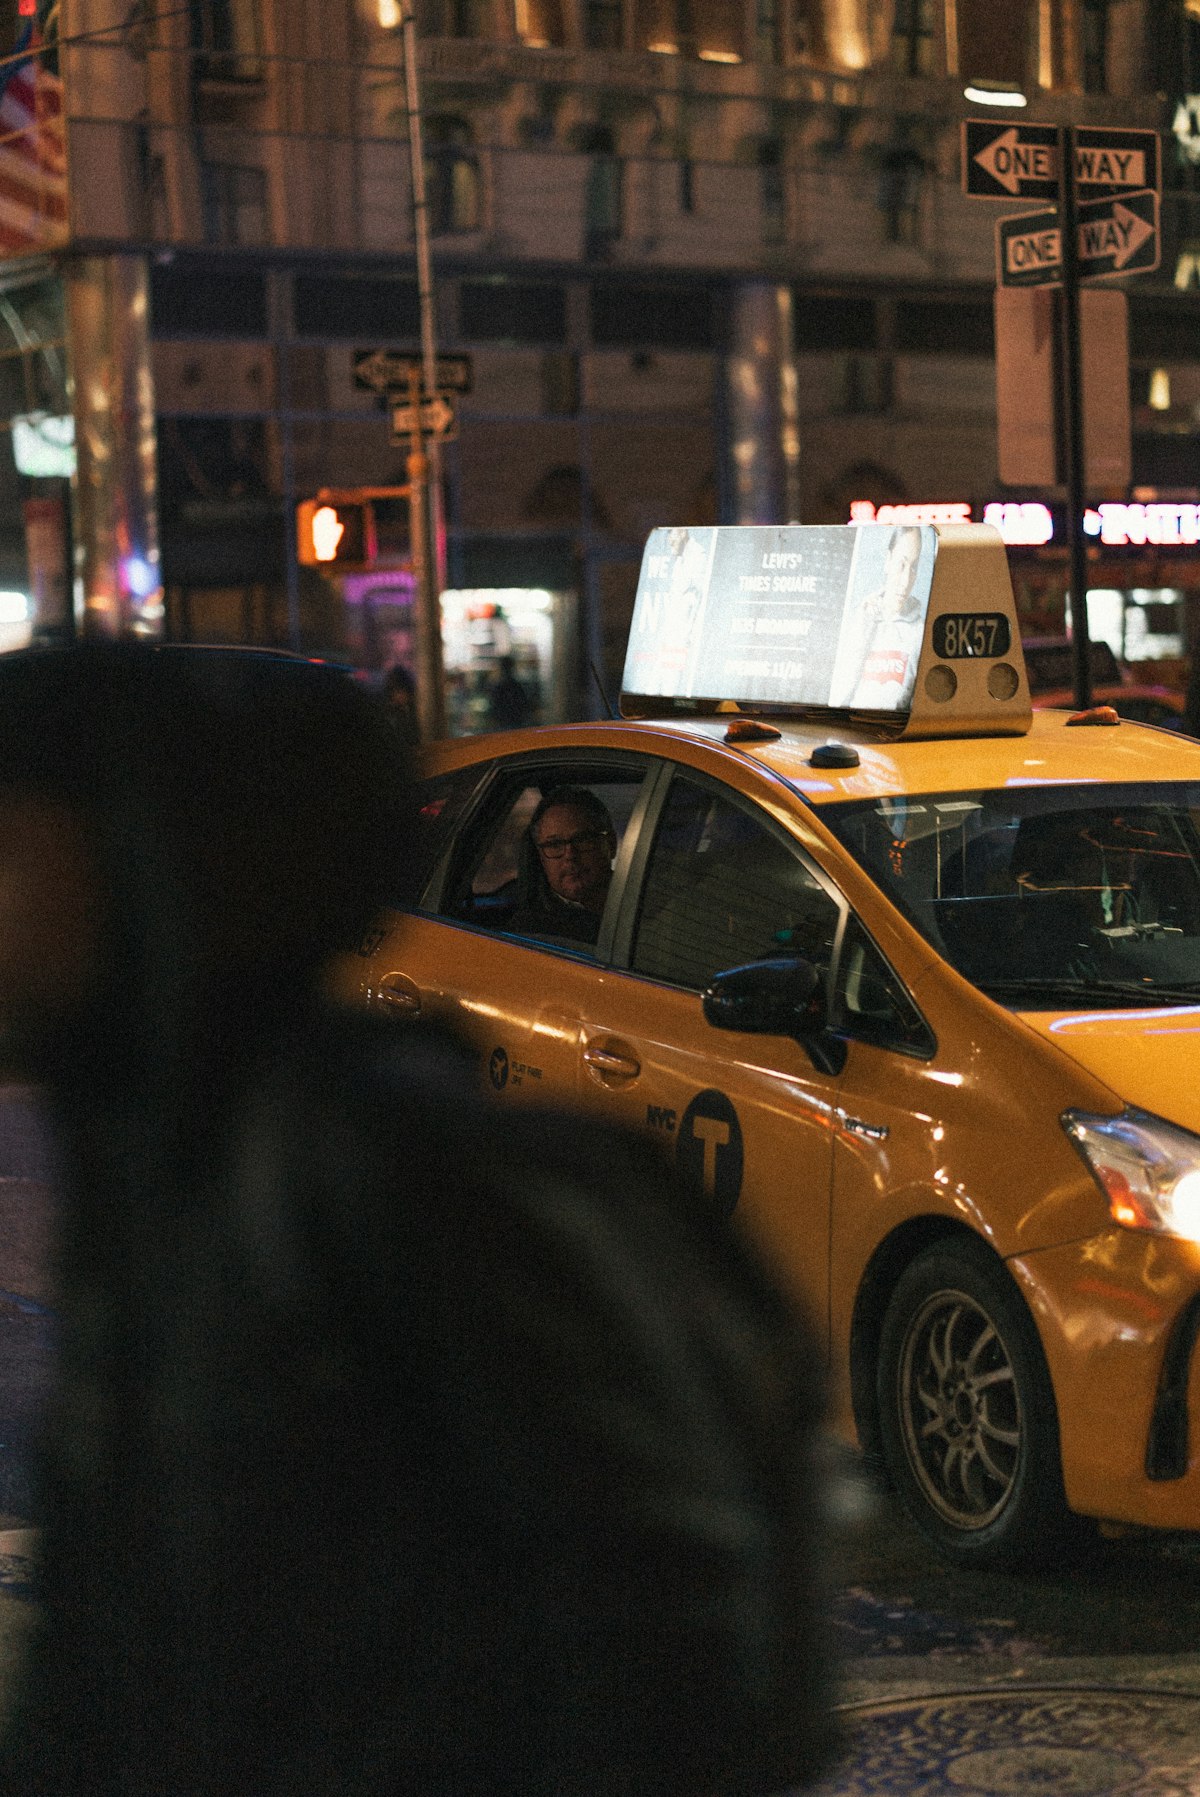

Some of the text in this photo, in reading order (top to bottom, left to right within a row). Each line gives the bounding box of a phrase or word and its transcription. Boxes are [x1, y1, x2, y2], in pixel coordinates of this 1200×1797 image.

[993, 147, 1133, 181] ONE WAY
[1012, 219, 1134, 267] ONE WAY
[738, 575, 817, 593] TIMES SQUARE
[945, 619, 999, 657] 8K57
[646, 1103, 677, 1133] NYC
